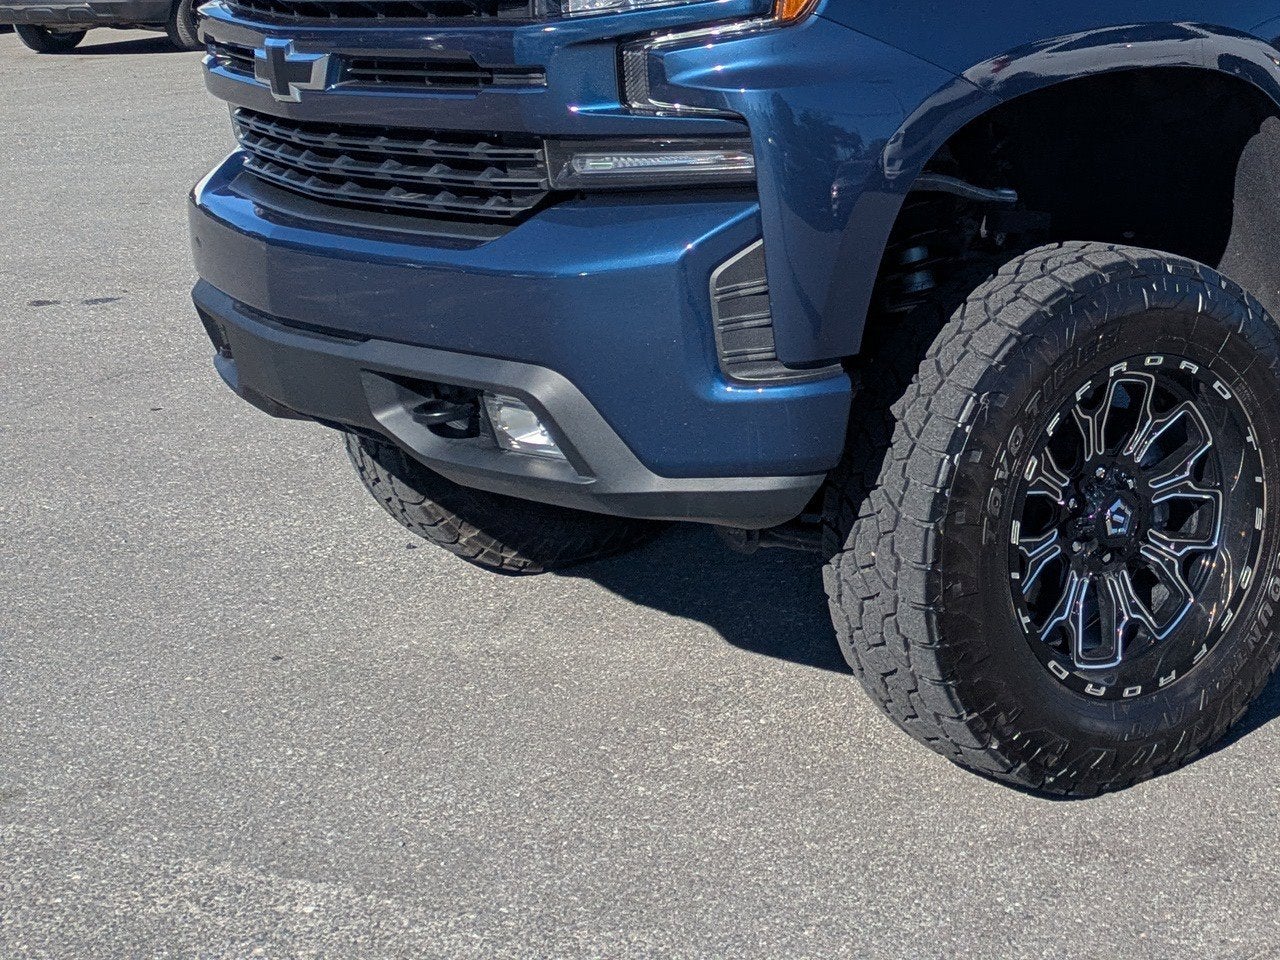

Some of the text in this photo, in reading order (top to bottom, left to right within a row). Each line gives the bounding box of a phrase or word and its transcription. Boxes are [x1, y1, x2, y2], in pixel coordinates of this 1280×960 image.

[983, 426, 1024, 544] TOYO
[1243, 426, 1264, 531] TIS
[1010, 519, 1031, 633] TIS
